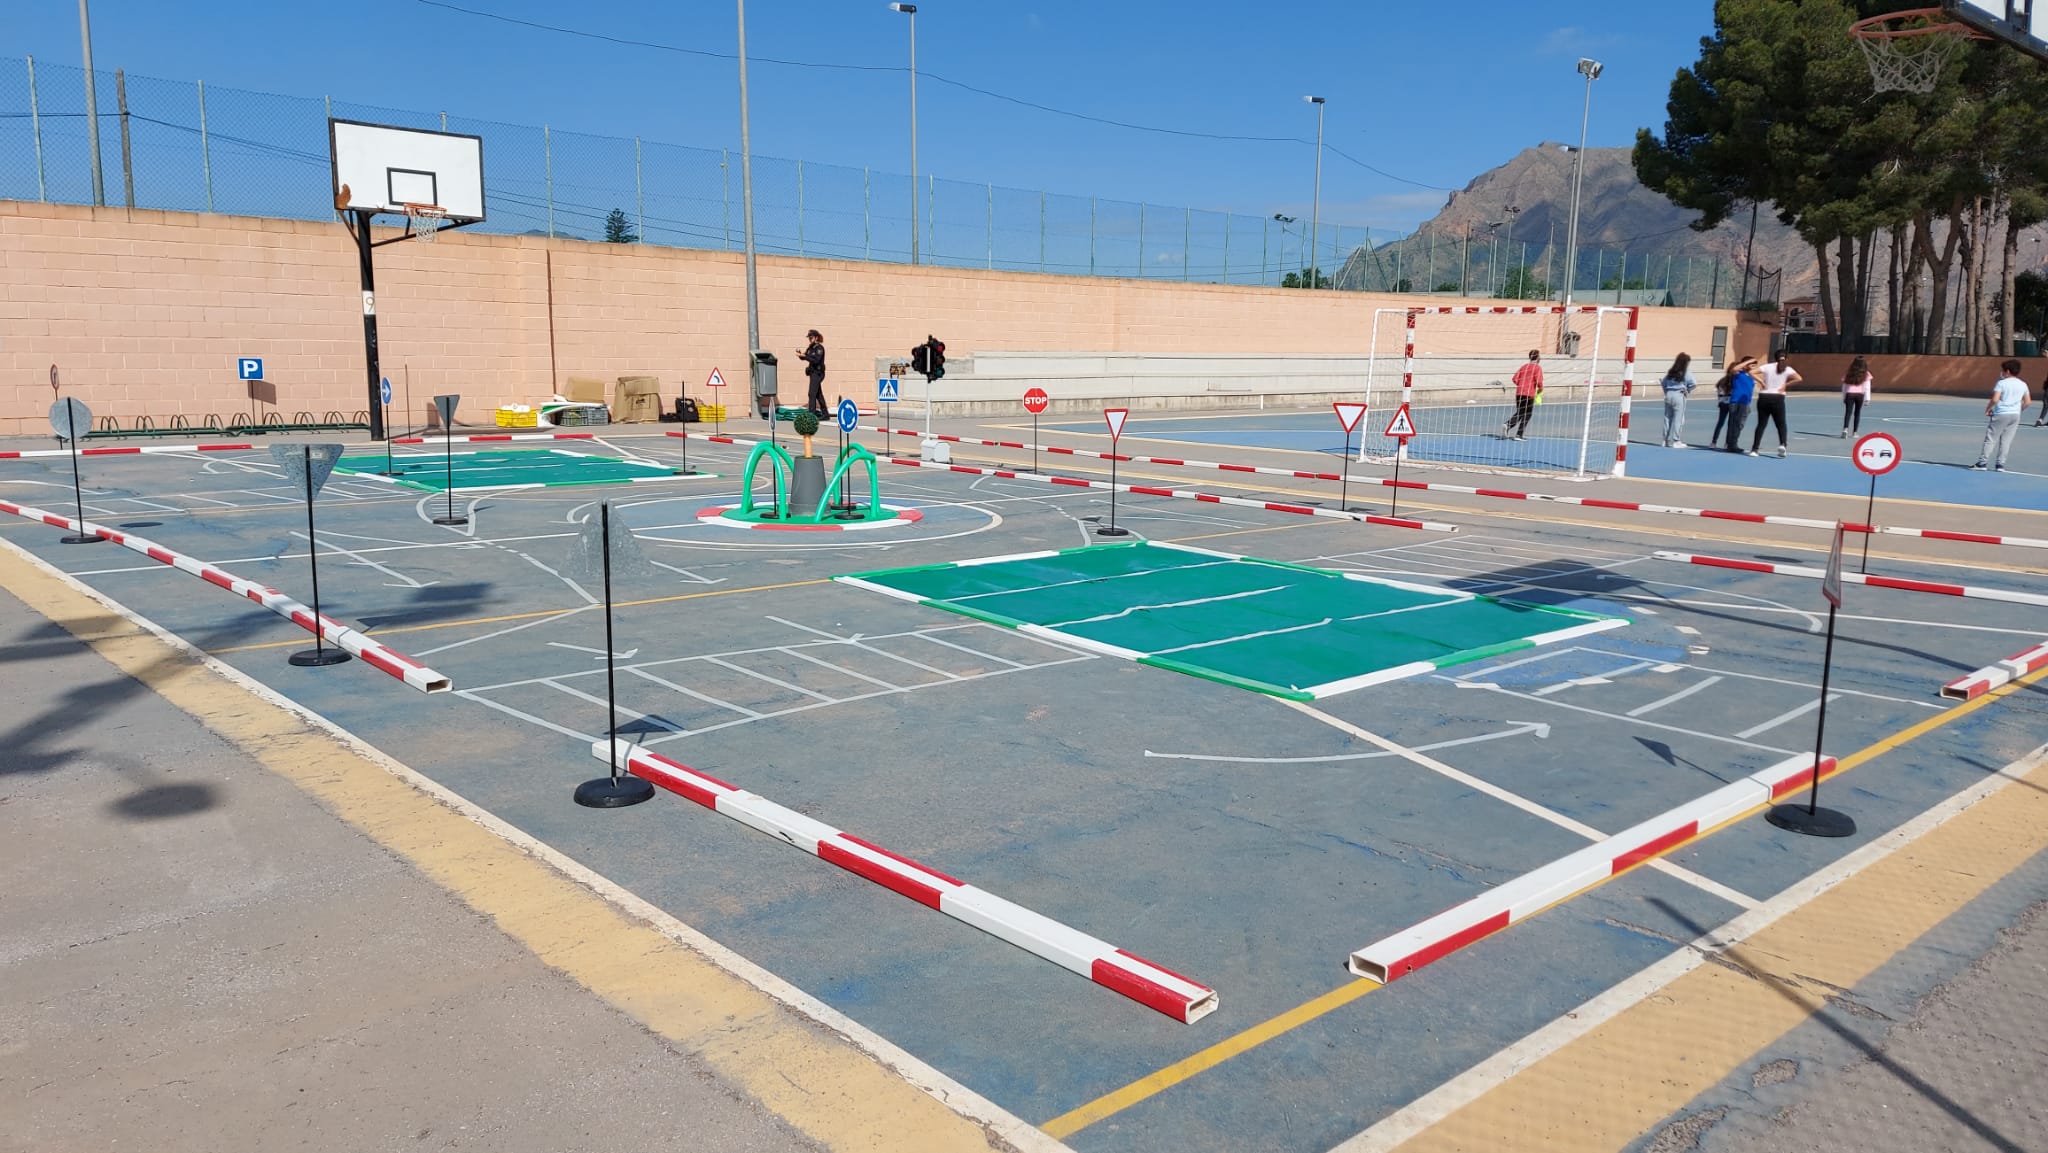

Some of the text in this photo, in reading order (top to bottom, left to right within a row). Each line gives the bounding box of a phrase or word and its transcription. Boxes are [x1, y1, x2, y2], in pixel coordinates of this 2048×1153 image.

[366, 297, 375, 313] 9
[243, 360, 258, 377] P
[1025, 397, 1047, 405] STOP
